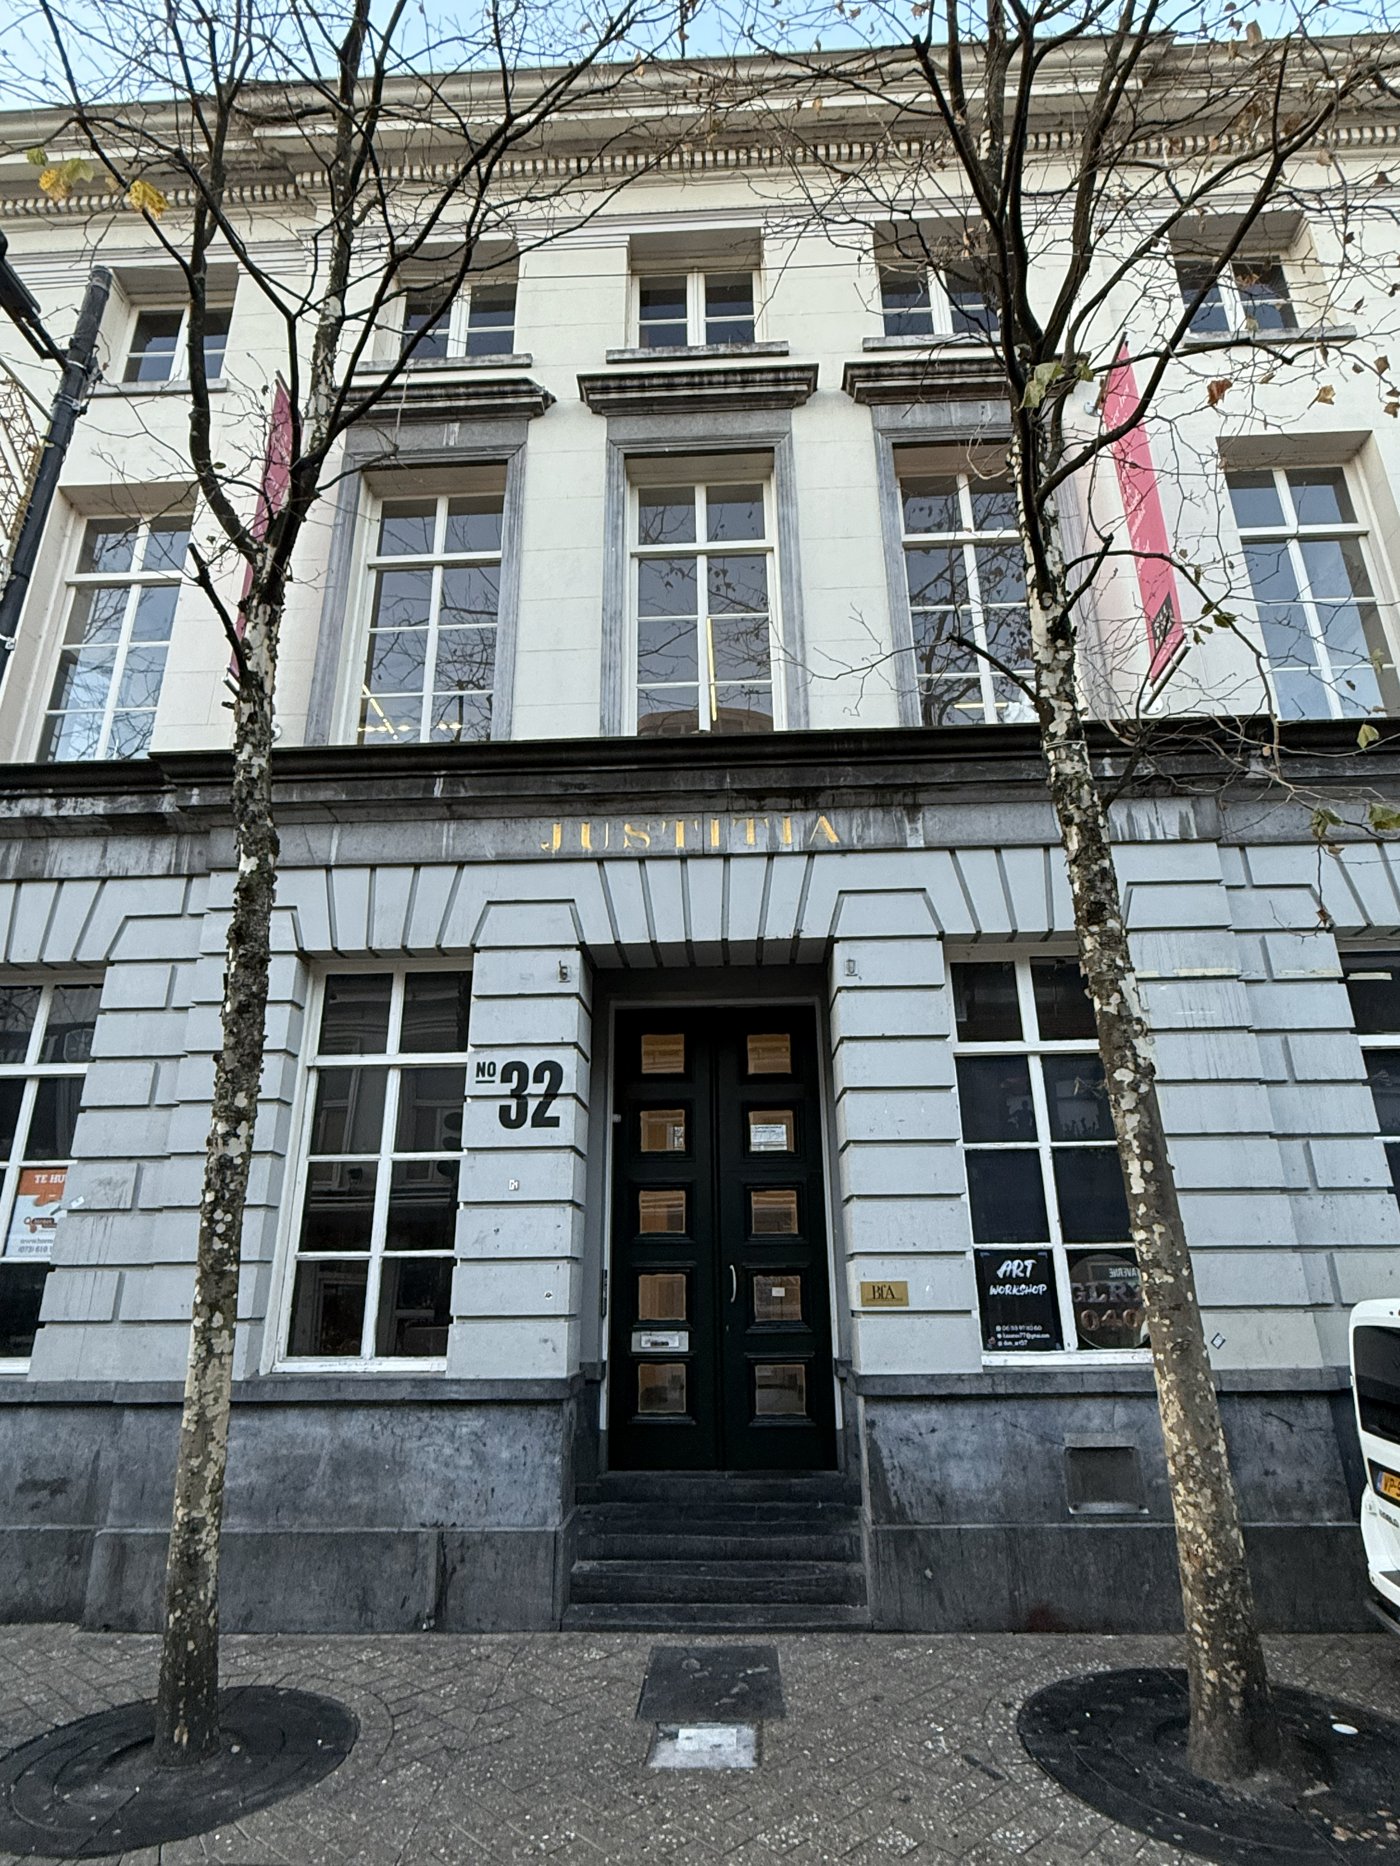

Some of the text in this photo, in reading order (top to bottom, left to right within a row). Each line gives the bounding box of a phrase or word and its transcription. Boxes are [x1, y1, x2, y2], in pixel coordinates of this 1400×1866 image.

[540, 815, 839, 851] JUSTITIA
[498, 1060, 563, 1129] 32
[34, 1174, 48, 1184] TE
[997, 1259, 1038, 1279] ART
[989, 1283, 1047, 1296] WORKSHOP
